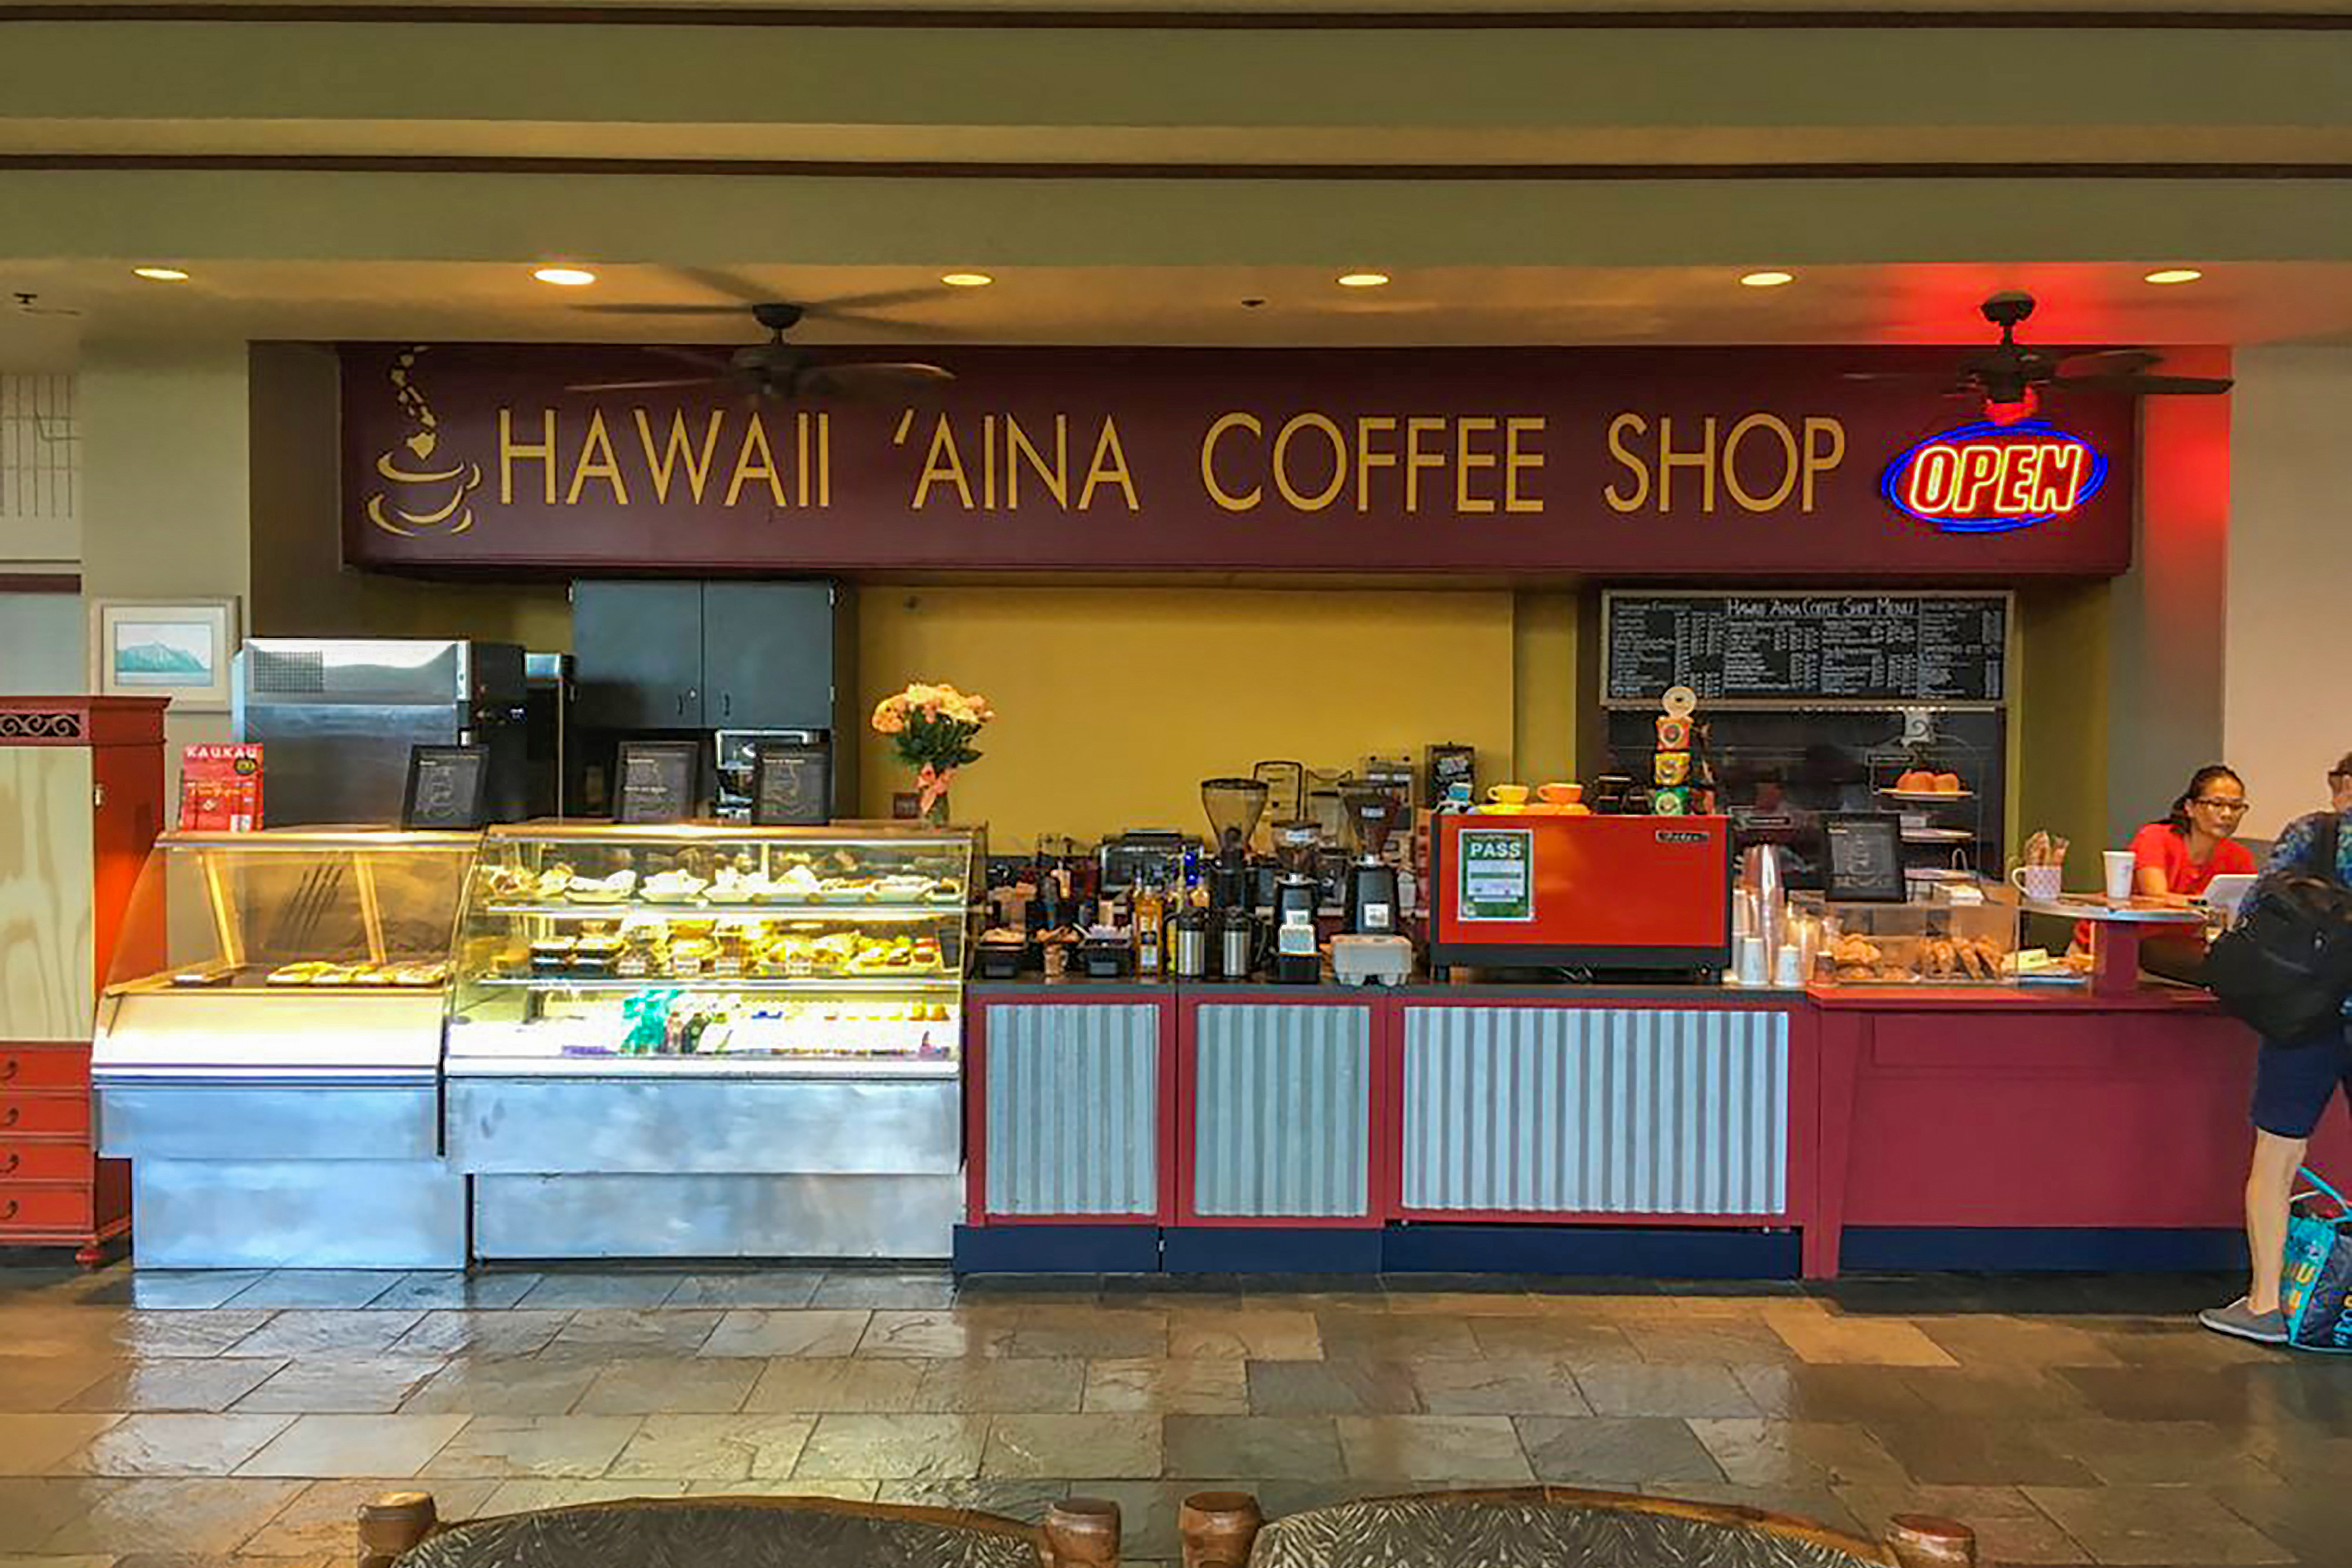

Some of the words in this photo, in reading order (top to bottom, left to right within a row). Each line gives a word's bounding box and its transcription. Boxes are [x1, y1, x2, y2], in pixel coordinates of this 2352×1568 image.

[499, 408, 830, 507] HAWAII
[1200, 411, 1545, 513] COFFEE
[1604, 411, 1846, 513] SHOP
[1909, 444, 2084, 513] OPEN
[186, 746, 257, 758] KAUKAU
[1470, 842, 1520, 857] PASS
